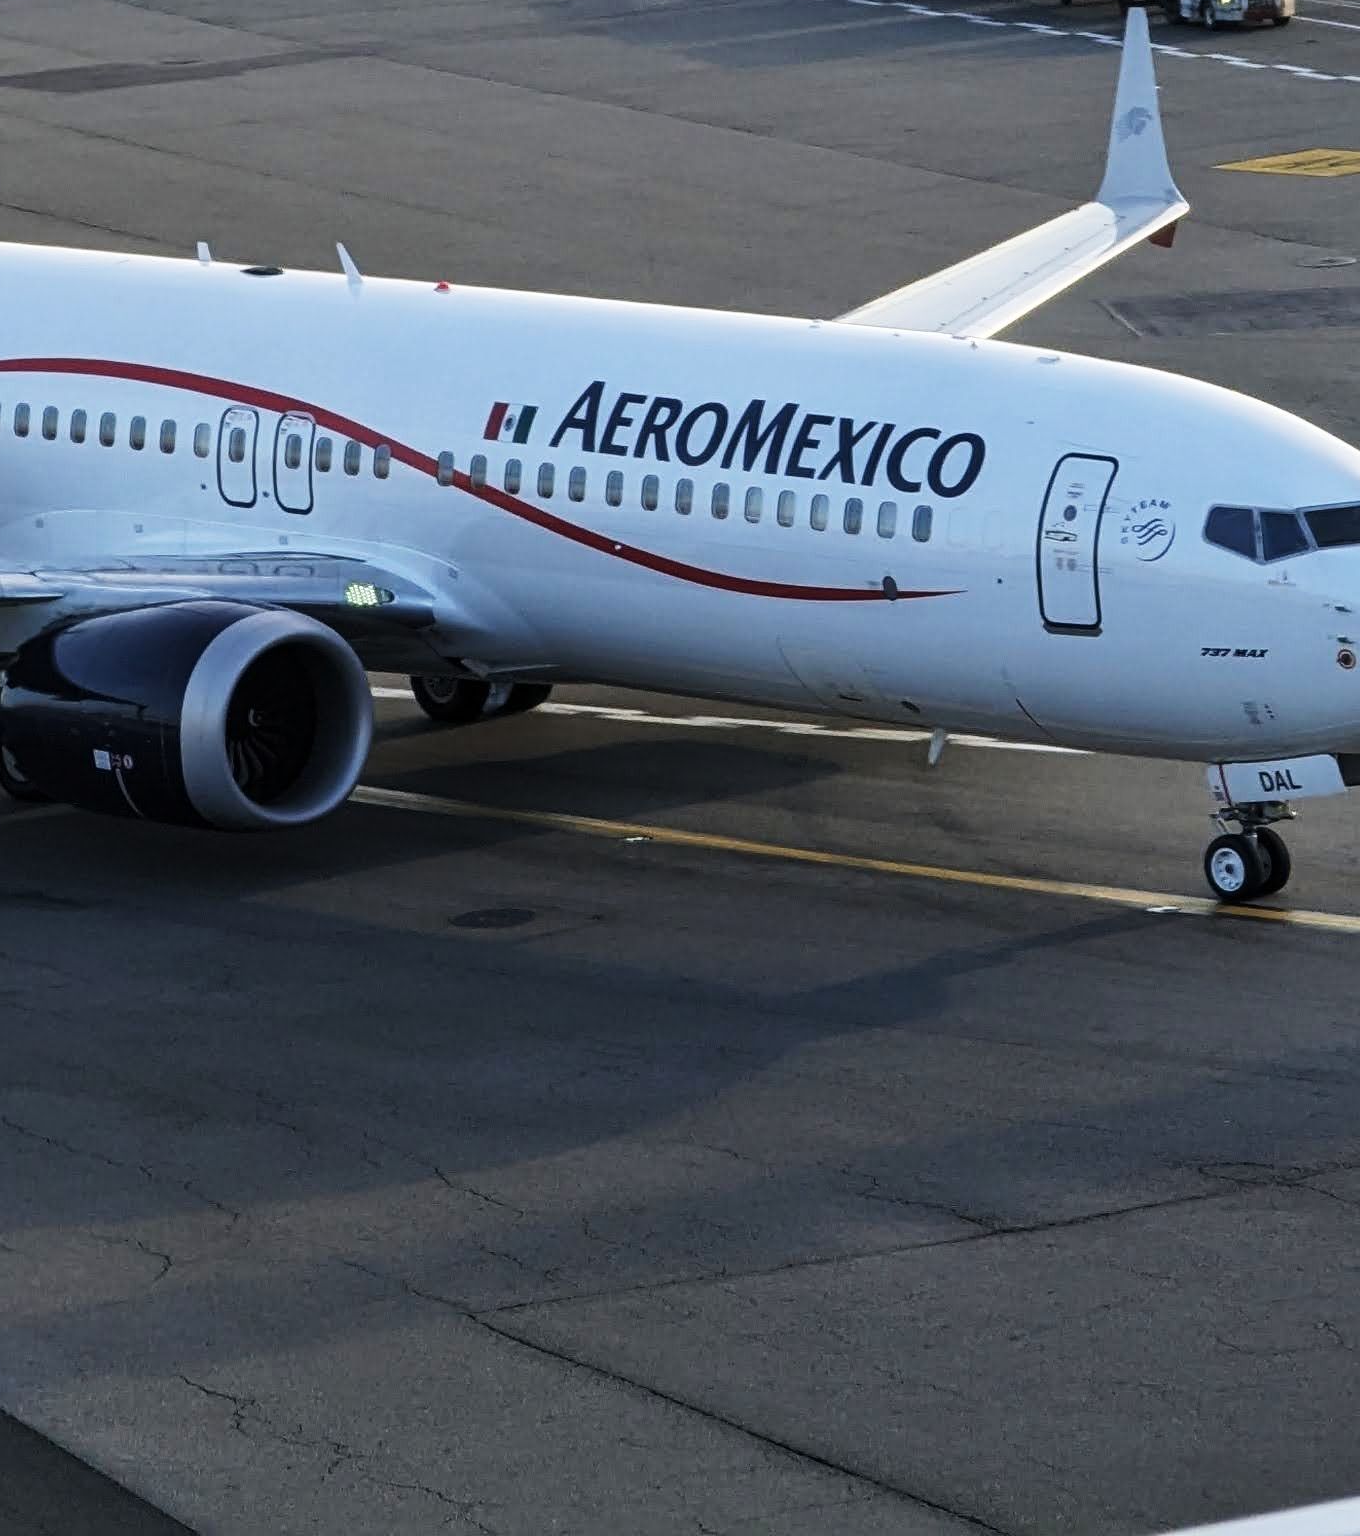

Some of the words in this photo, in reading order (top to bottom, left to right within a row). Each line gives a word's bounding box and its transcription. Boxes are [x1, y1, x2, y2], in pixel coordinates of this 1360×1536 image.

[1201, 647, 1231, 657] 737
[1233, 648, 1269, 658] MAX
[1258, 769, 1303, 792] DAL
